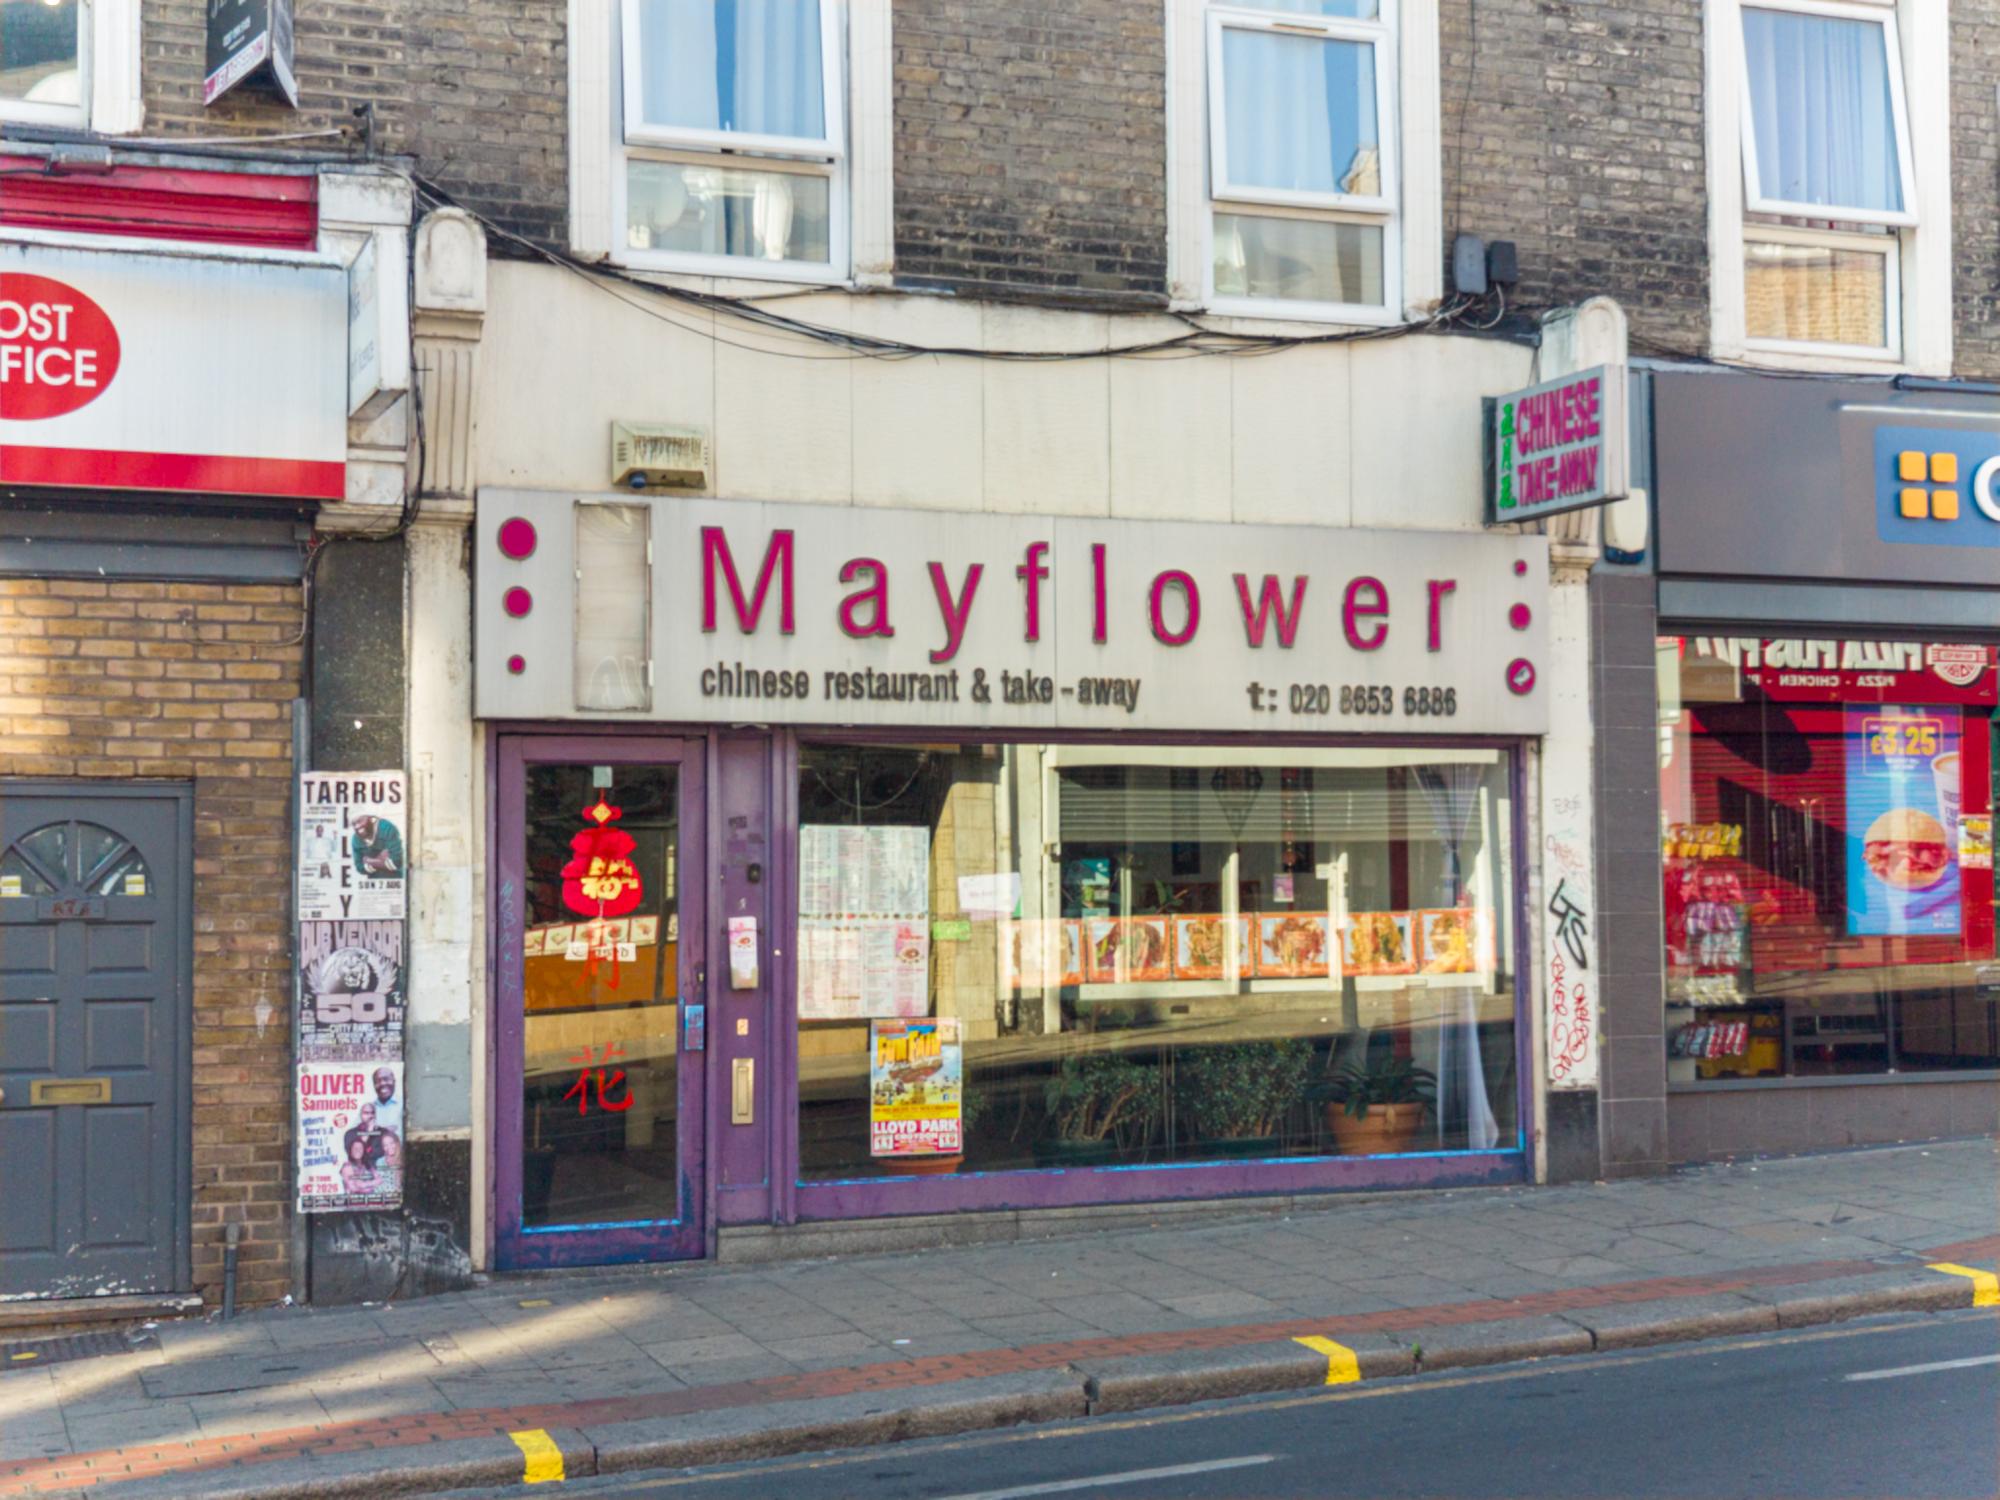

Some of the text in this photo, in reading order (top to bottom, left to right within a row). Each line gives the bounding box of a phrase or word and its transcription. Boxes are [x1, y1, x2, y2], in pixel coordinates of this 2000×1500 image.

[0, 301, 74, 342] OST
[1516, 377, 1600, 456] CHINESE
[1517, 445, 1599, 507] TAKE-AWAY
[701, 525, 1457, 664] Mayflower
[701, 660, 810, 699] chinese
[824, 666, 959, 703] restaurant
[970, 667, 992, 704] &
[1246, 682, 1457, 717] t: 020 8653 6886
[303, 781, 402, 805] TARRUS
[316, 992, 387, 1023] 50
[301, 1074, 365, 1096] OLIVER
[302, 1097, 358, 1111] Samuels
[874, 1118, 958, 1134] LLOYD PARK
